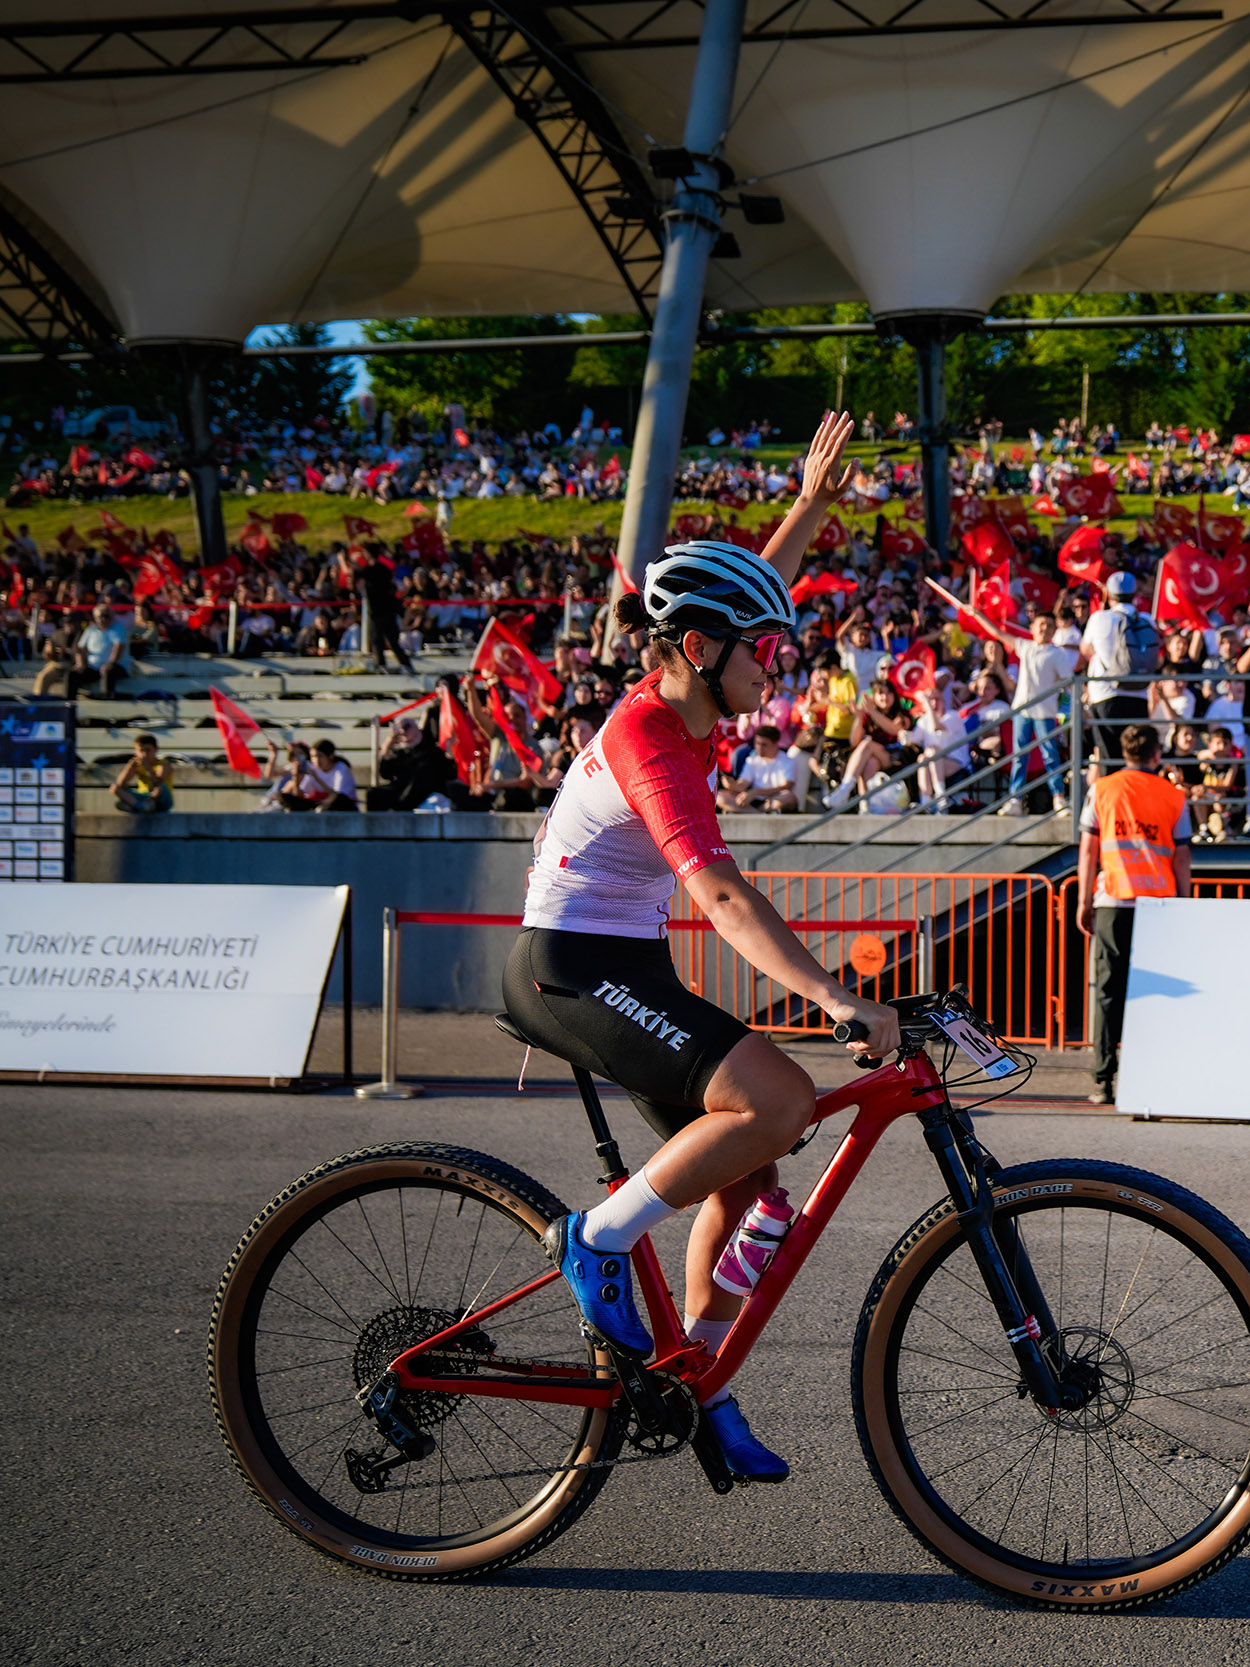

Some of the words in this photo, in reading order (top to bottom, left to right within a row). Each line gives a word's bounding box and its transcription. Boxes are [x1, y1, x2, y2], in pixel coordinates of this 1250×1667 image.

[6, 931, 96, 956] TÜRKİYE
[100, 933, 260, 958] CUMHURİYETİ
[592, 980, 692, 1051] TÜRKİYE
[959, 1027, 993, 1058] 16
[423, 1166, 520, 1210] MAXXIS
[994, 1188, 1028, 1208] EKON
[1029, 1183, 1074, 1197] RACE
[348, 1544, 390, 1564] RACE
[388, 1555, 441, 1568] REKON
[1031, 1578, 1140, 1597] MAXXIS
